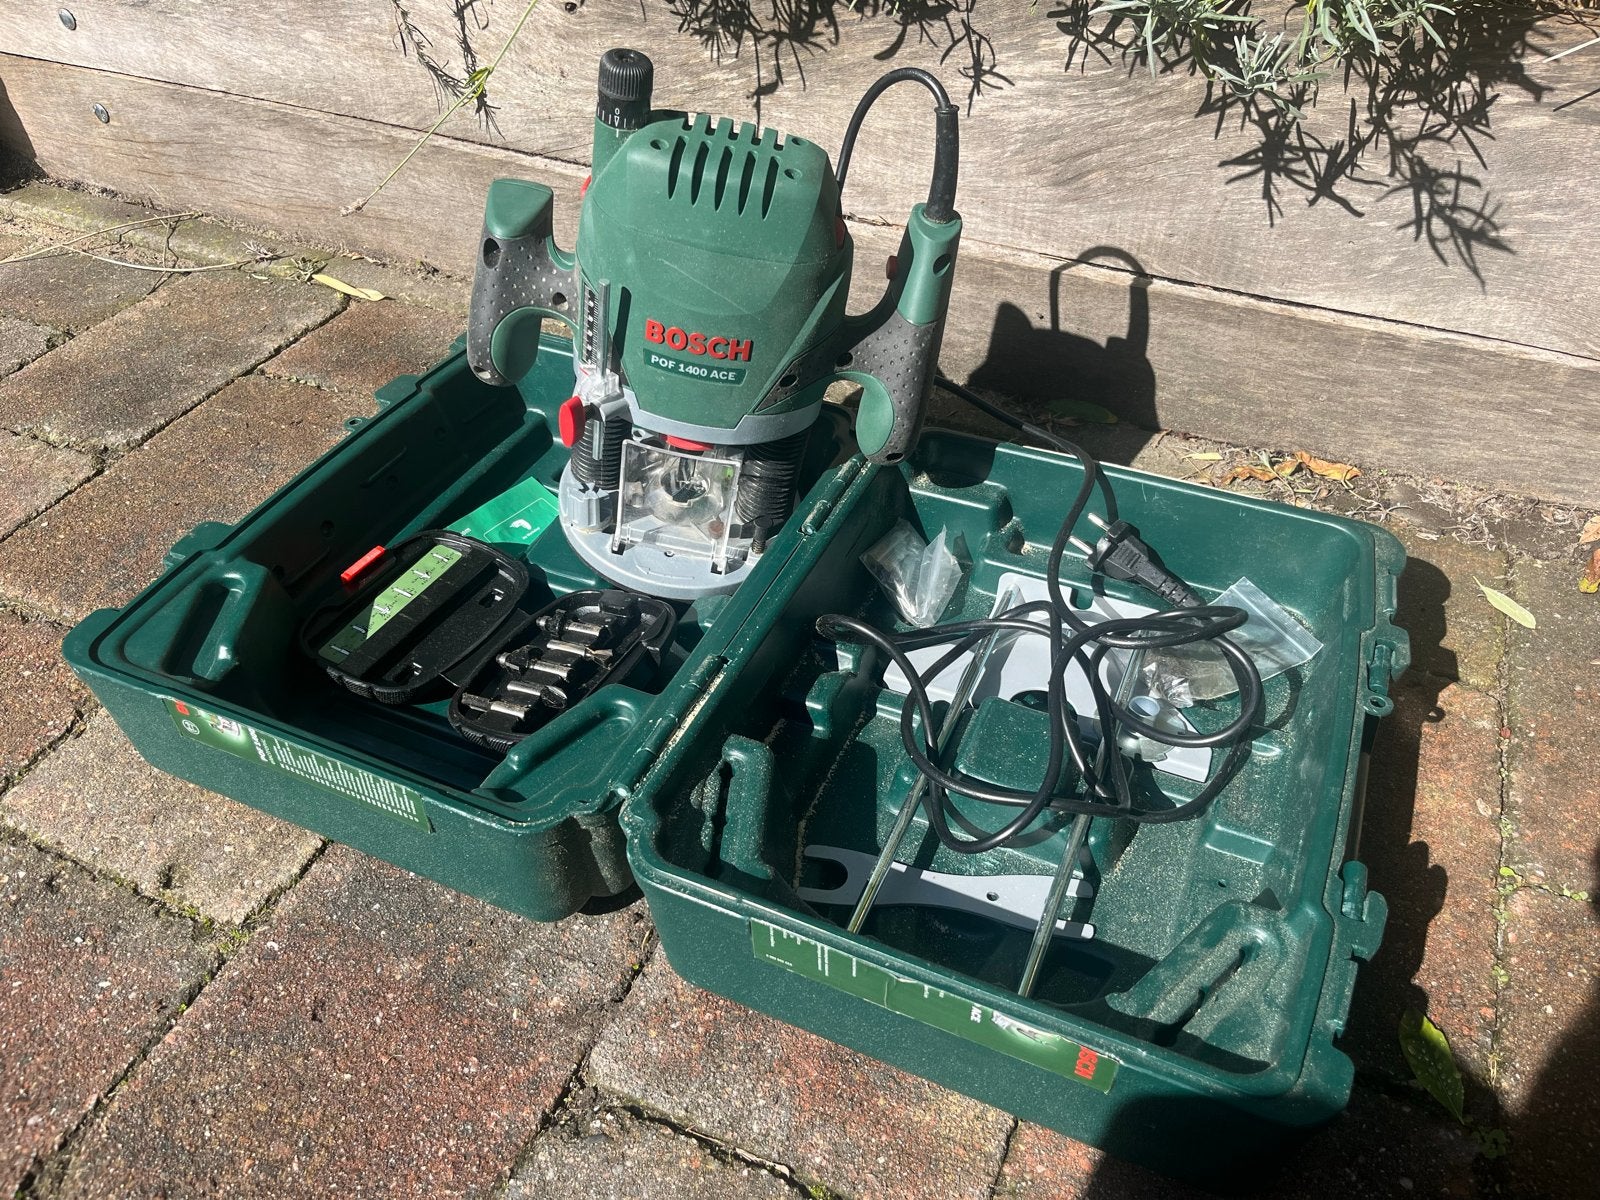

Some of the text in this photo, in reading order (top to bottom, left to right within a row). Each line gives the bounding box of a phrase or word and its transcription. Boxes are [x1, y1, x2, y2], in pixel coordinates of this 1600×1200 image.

[645, 318, 752, 361] BOSCH
[651, 354, 736, 381] POF 1400 ACE
